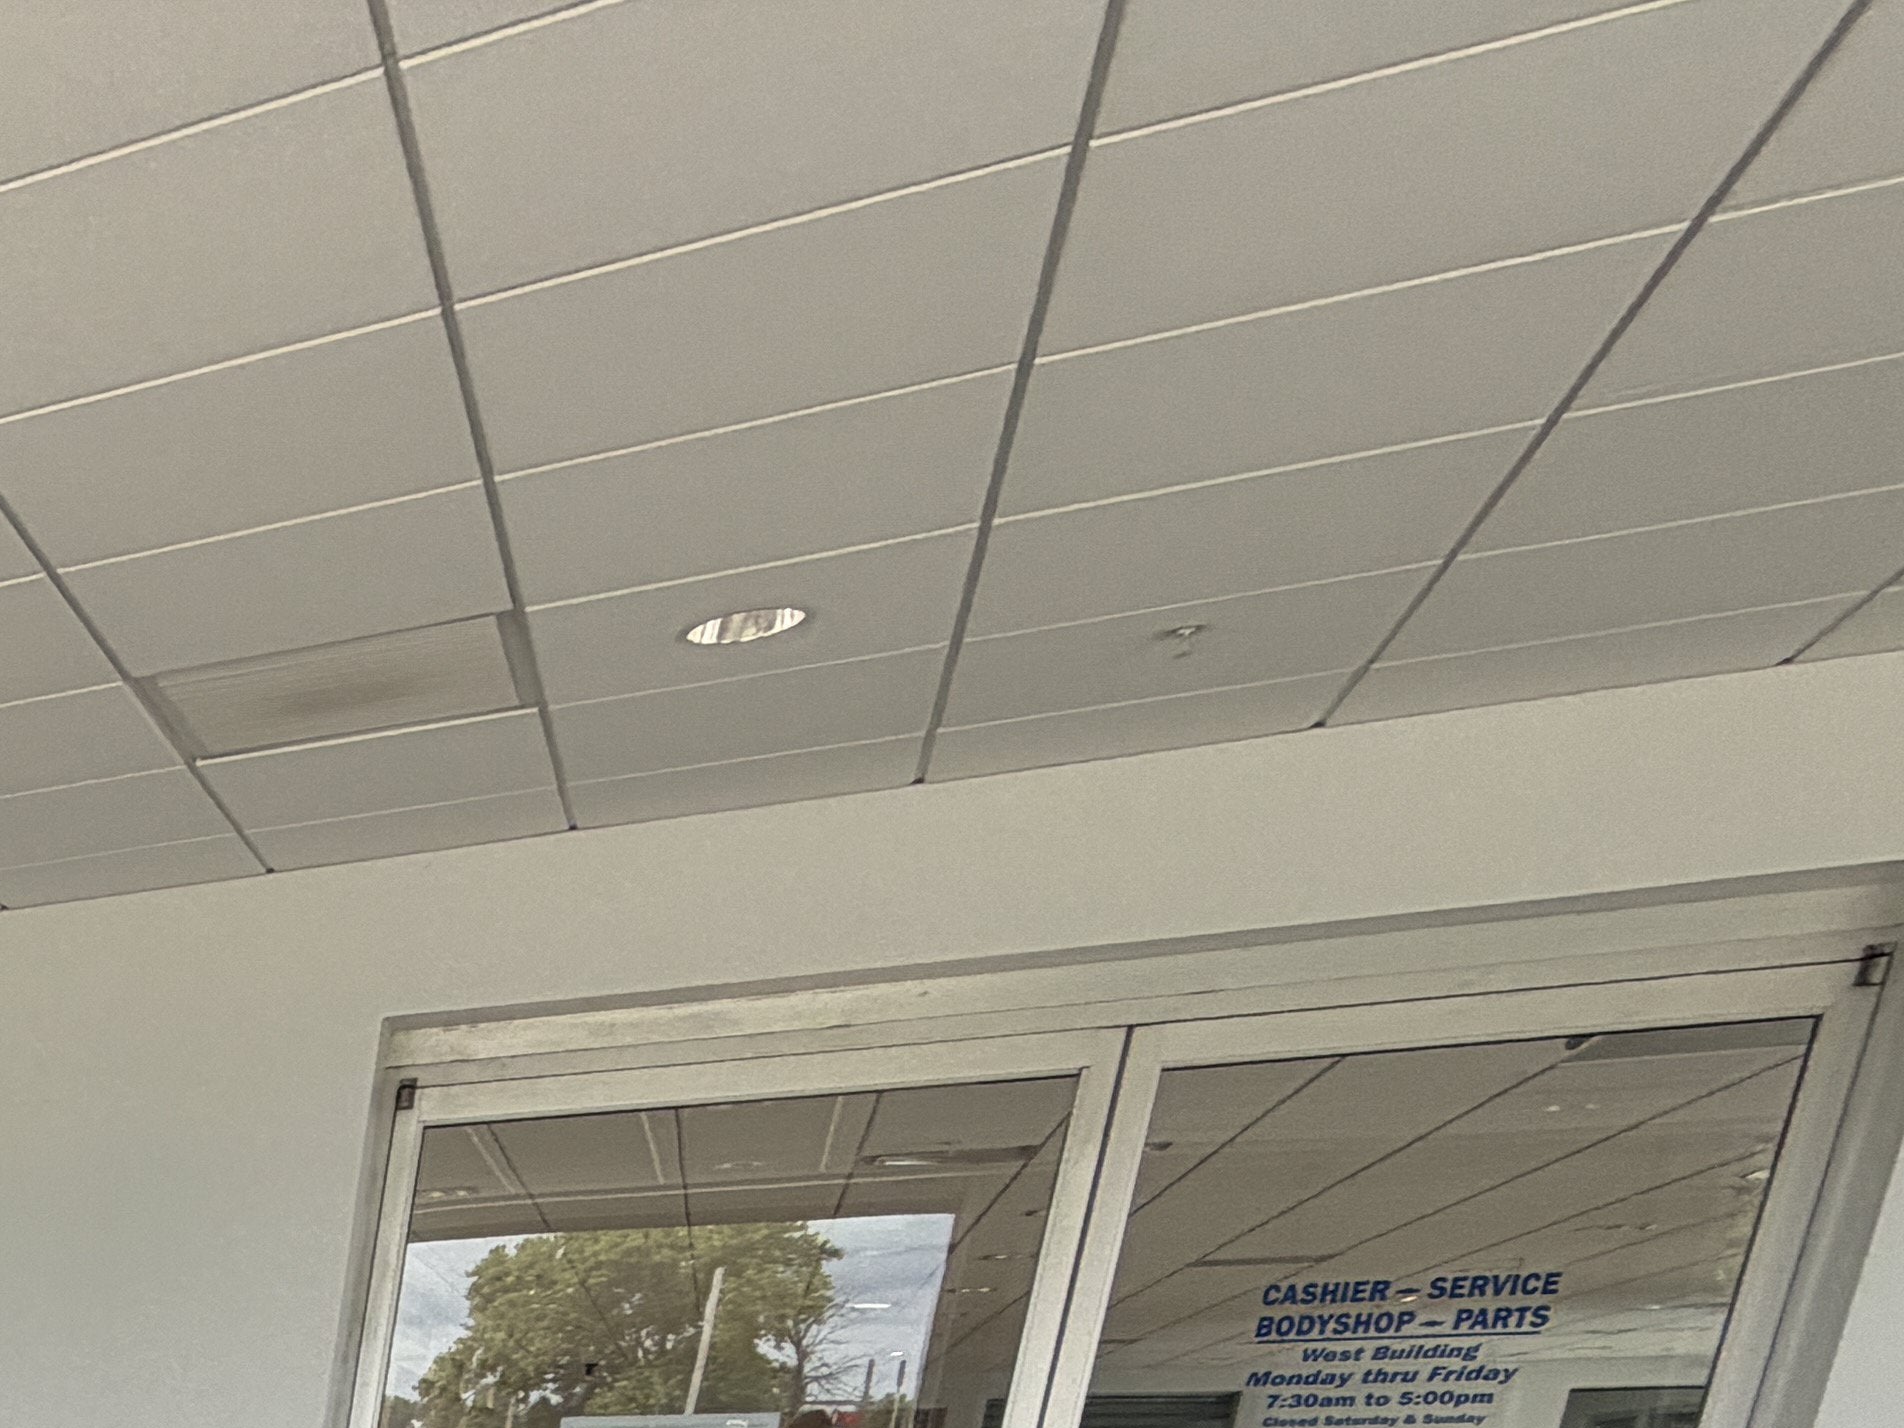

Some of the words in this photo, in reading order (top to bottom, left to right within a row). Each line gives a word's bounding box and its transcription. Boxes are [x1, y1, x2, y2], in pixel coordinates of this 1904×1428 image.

[1262, 1280, 1392, 1306] CASHIER
[1427, 1272, 1563, 1299] SERVICE
[1255, 1310, 1417, 1338] BODYSHOP
[1452, 1305, 1552, 1330] PARTS
[1302, 1347, 1362, 1363] West
[1371, 1342, 1483, 1362] Building
[1246, 1371, 1354, 1388] Monday
[1362, 1368, 1418, 1385] thru
[1427, 1365, 1520, 1385] Friday
[1266, 1393, 1355, 1409] 7:30am
[1364, 1393, 1389, 1407] to
[1398, 1391, 1495, 1407] 5:00pm
[1262, 1415, 1319, 1428] Closed
[1323, 1414, 1399, 1427] Saturday
[1422, 1413, 1487, 1426] Sunday
